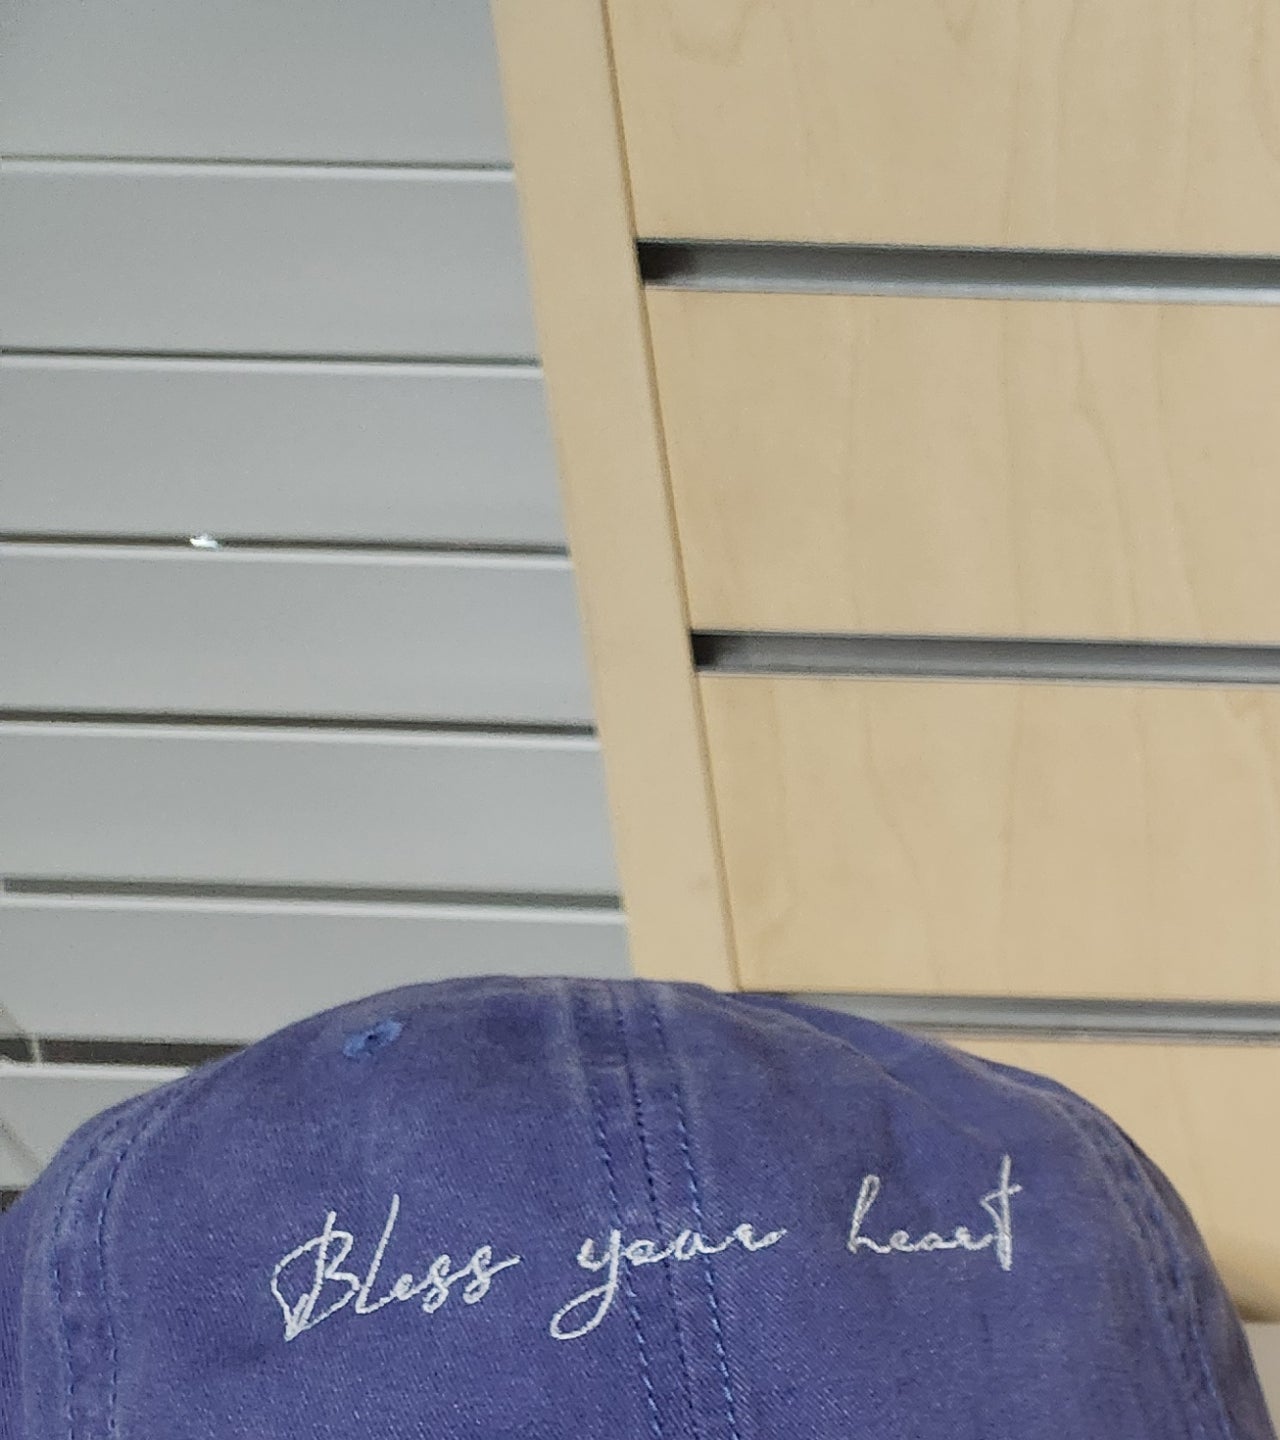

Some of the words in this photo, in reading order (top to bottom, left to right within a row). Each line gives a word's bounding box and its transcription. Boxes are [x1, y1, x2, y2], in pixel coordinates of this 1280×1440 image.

[271, 1194, 522, 1341] Bless
[550, 1221, 787, 1340] your
[847, 1155, 1023, 1271] heart
